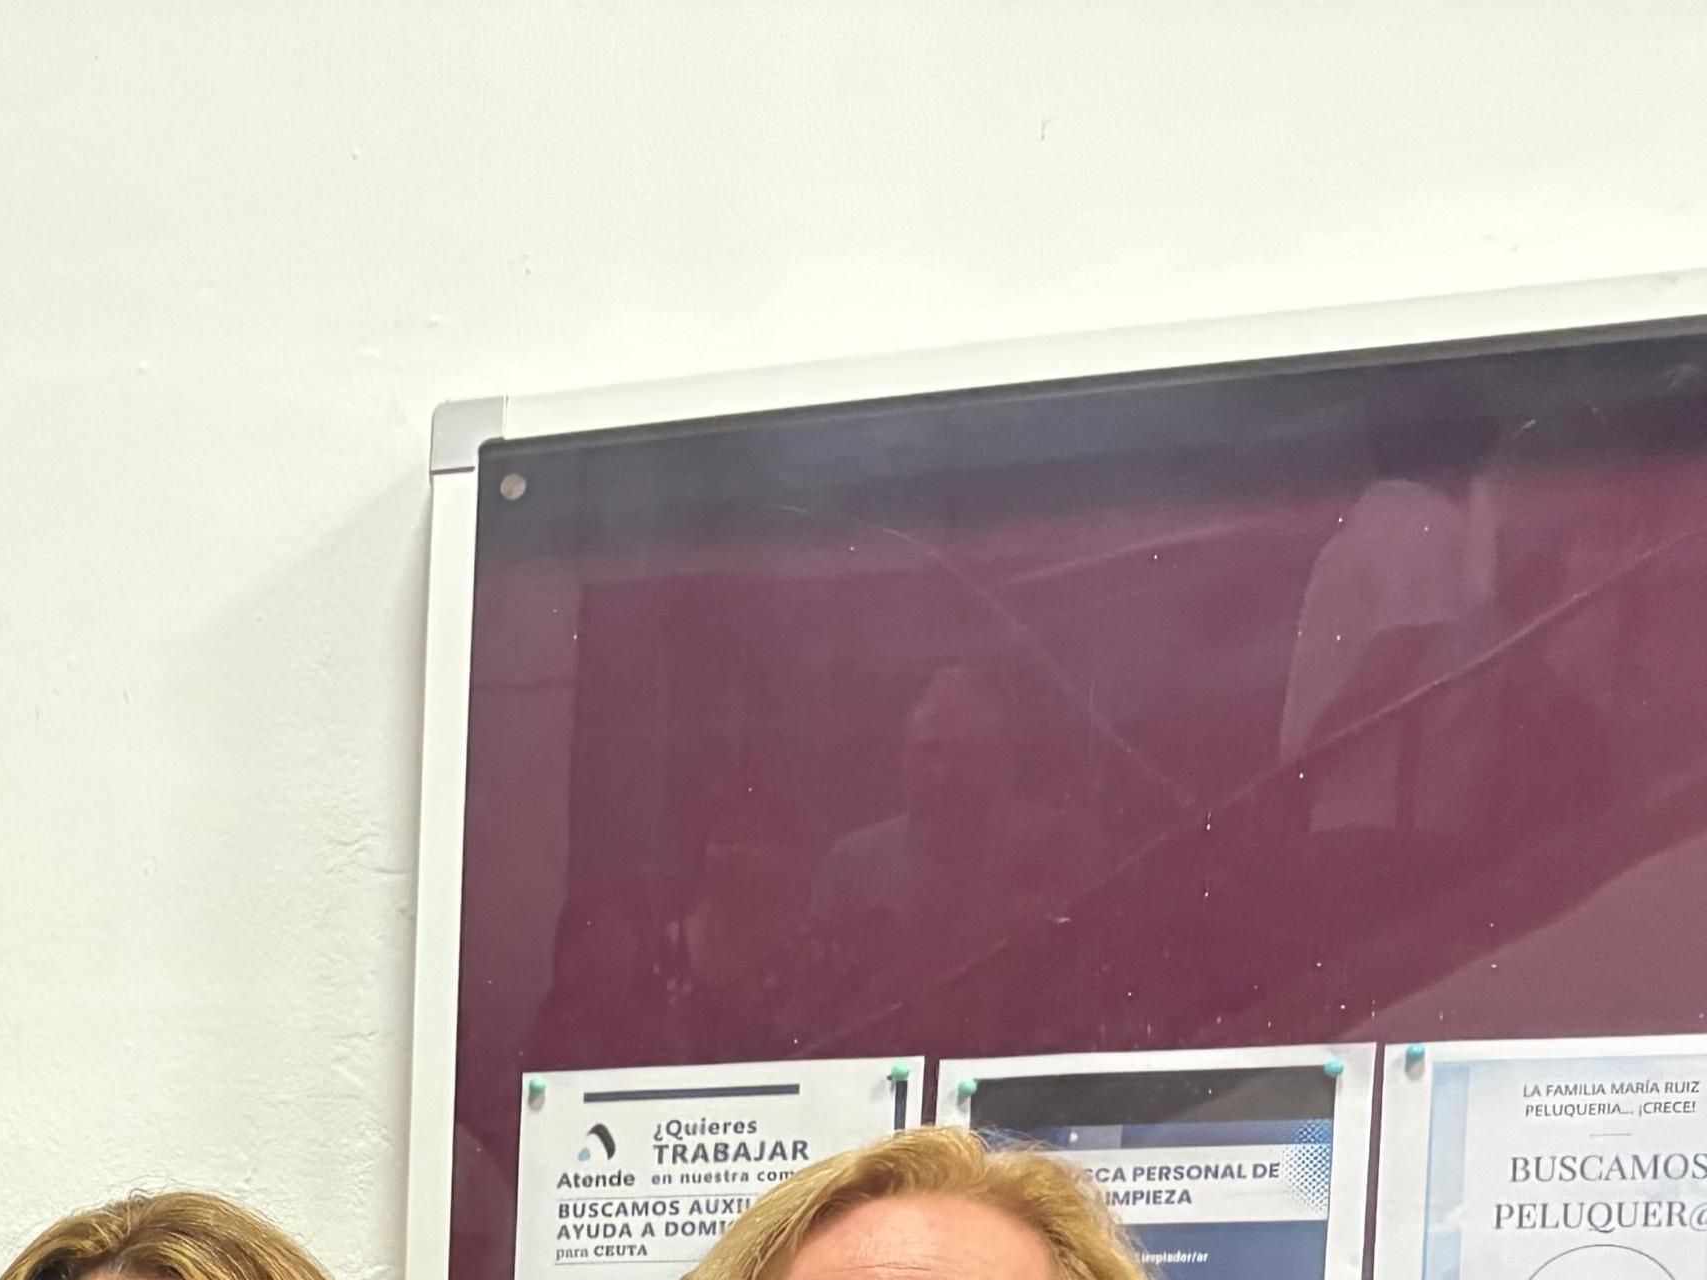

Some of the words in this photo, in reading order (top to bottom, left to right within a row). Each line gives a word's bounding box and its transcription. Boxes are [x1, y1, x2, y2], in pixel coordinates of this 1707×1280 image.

[1523, 1084, 1541, 1098] LA
[1546, 1083, 1605, 1097] FAMILIA
[1610, 1079, 1660, 1095] MARÍA
[1665, 1081, 1700, 1094] RUIZ
[1638, 1101, 1696, 1117] ¡CRECE!
[653, 1118, 757, 1141] ¿Quieres
[653, 1140, 809, 1164] TRABAJAR
[652, 1172, 671, 1184] en
[680, 1170, 749, 1184] nuestra
[1132, 1164, 1247, 1182] PERSONAL
[1252, 1163, 1280, 1178] DE
[1510, 1153, 1707, 1183] BUSCAMOS
[558, 1200, 680, 1219] BUSCAMOS
[557, 1223, 632, 1240] AYUDA
[641, 1221, 655, 1238] A
[664, 1220, 734, 1236] DOMI
[556, 1246, 588, 1261] para
[594, 1245, 647, 1257] CEUTA
